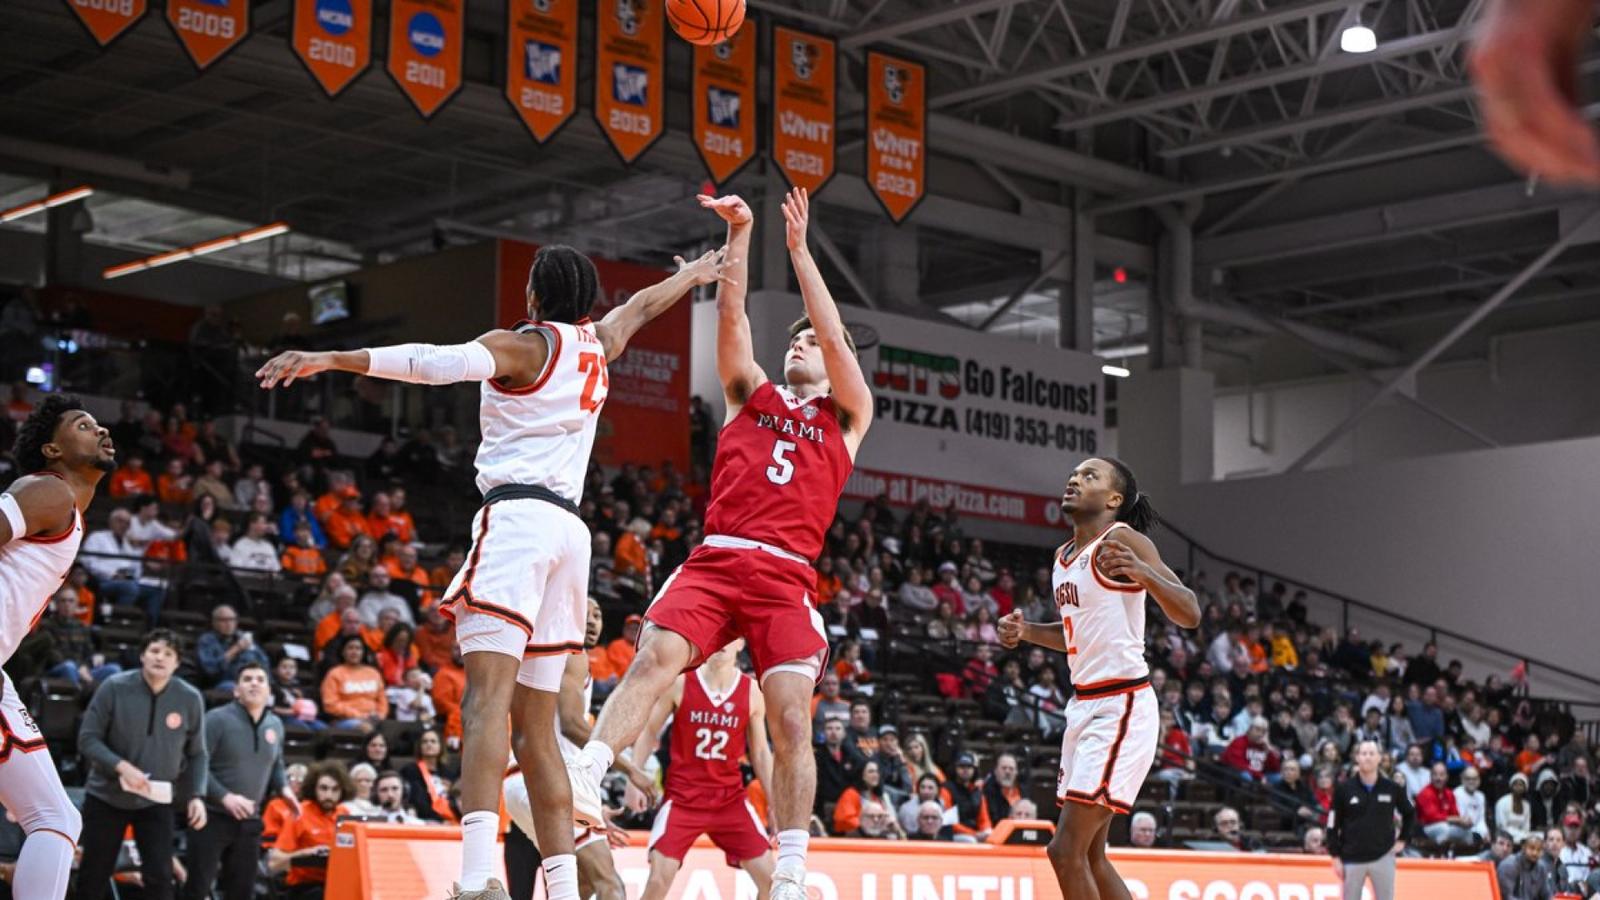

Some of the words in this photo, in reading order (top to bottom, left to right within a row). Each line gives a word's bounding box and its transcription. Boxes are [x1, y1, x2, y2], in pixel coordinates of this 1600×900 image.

[179, 8, 235, 38] 2009
[308, 38, 356, 68] 2010
[405, 60, 446, 89] 2011
[520, 87, 563, 115] 2012
[609, 109, 651, 135] 2013
[964, 359, 995, 398] Go
[1001, 365, 1097, 417] Falcons!
[757, 413, 825, 443] MIAMI
[876, 395, 960, 433] PIZZA
[965, 407, 1010, 441] (419)
[1014, 415, 1097, 455] 353-0316
[766, 439, 797, 485] 5
[690, 710, 739, 729] MIAMI
[695, 728, 729, 761] 22
